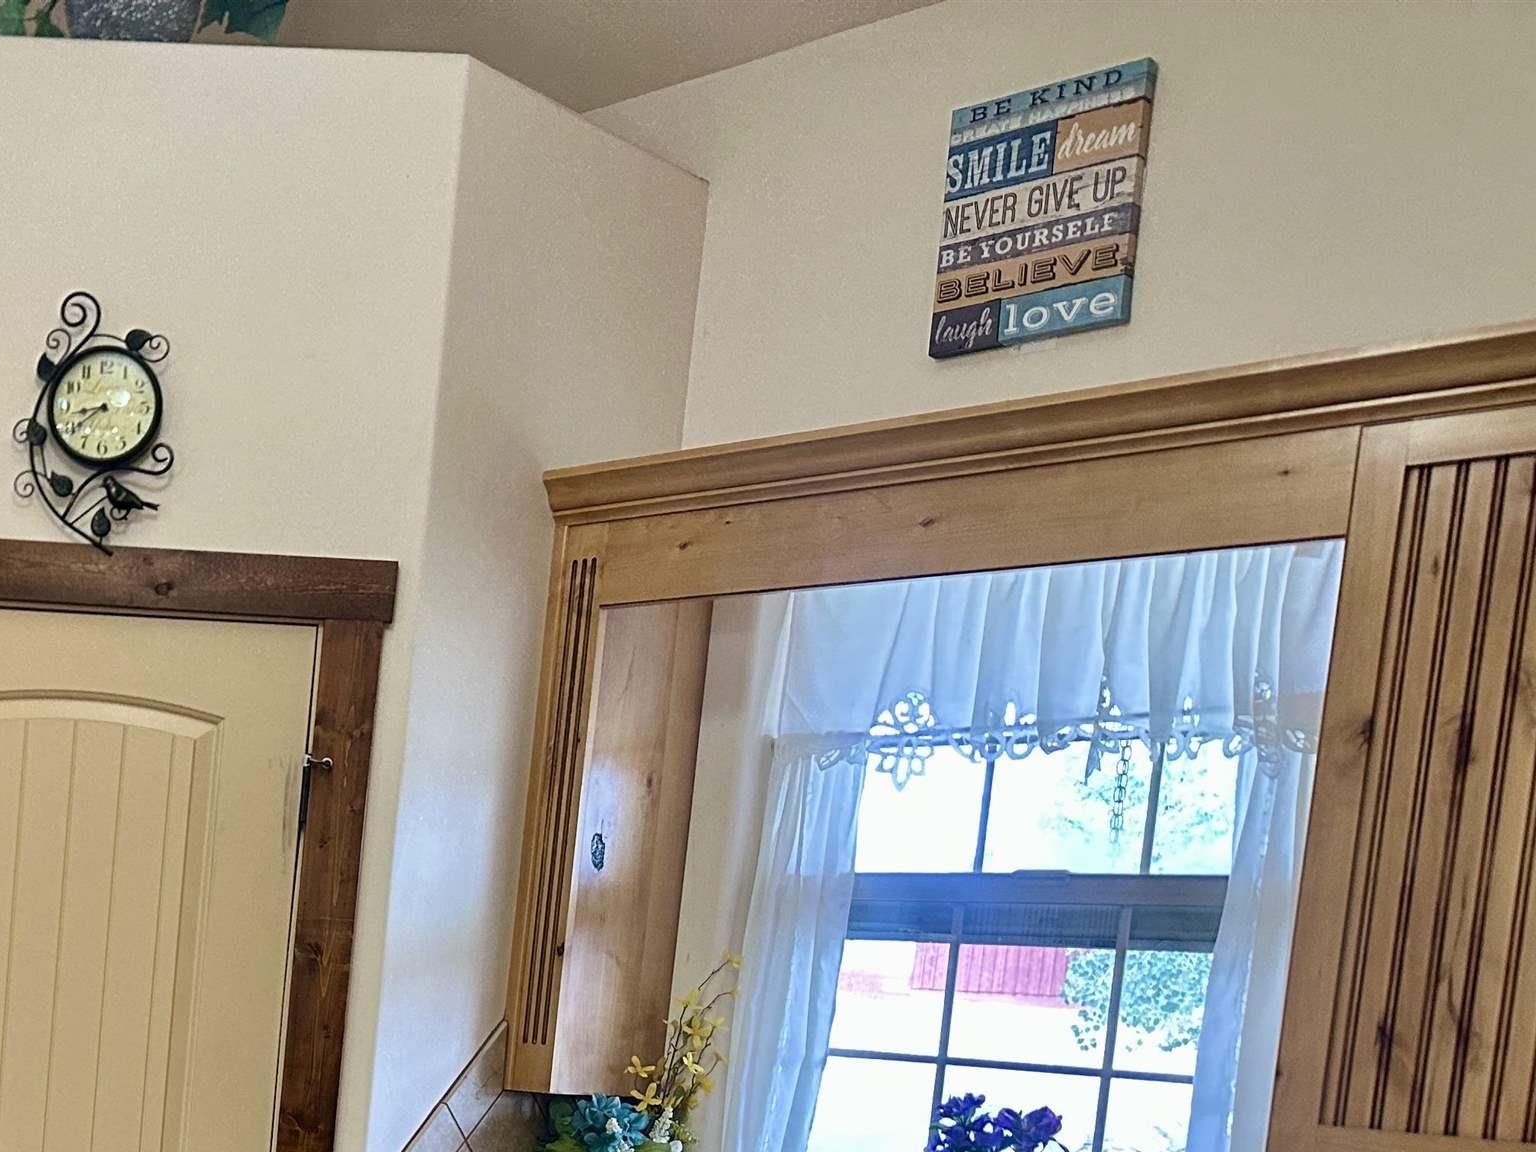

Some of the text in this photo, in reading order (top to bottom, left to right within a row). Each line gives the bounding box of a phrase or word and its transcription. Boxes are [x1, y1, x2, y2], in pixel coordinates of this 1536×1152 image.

[970, 69, 1123, 123] BE KIND
[947, 121, 1136, 193] SMILE dream
[943, 166, 1126, 238] NEVER GIVE UP
[939, 213, 1118, 268] BE YOURSELF
[937, 243, 1120, 303] BELIEVE
[935, 291, 1116, 348] laugh love
[67, 381, 81, 394] 10
[82, 365, 91, 379] 11
[100, 360, 114, 375] 12
[135, 379, 145, 394] 2
[97, 440, 108, 455] 6
